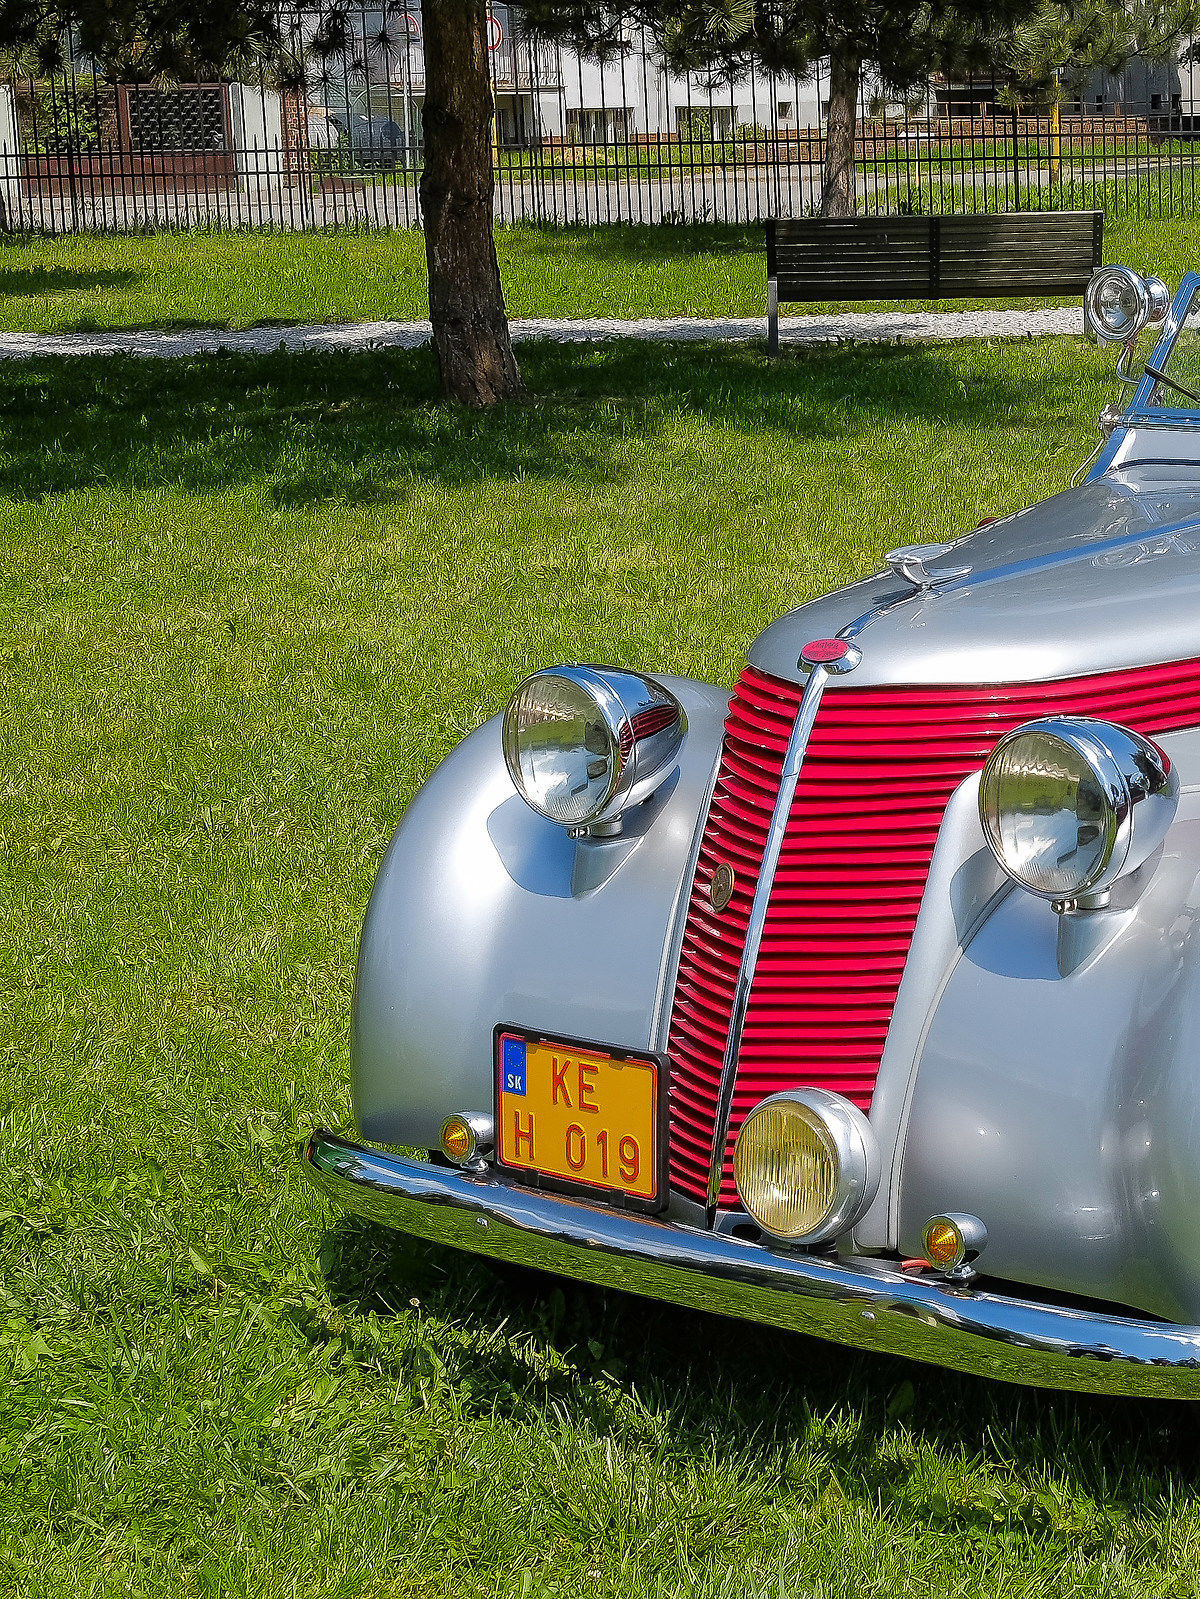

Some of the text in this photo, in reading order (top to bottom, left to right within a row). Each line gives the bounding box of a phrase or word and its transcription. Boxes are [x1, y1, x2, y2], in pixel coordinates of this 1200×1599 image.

[507, 1073, 523, 1091] SK
[552, 1056, 599, 1114] KE
[514, 1109, 640, 1184] H 019
